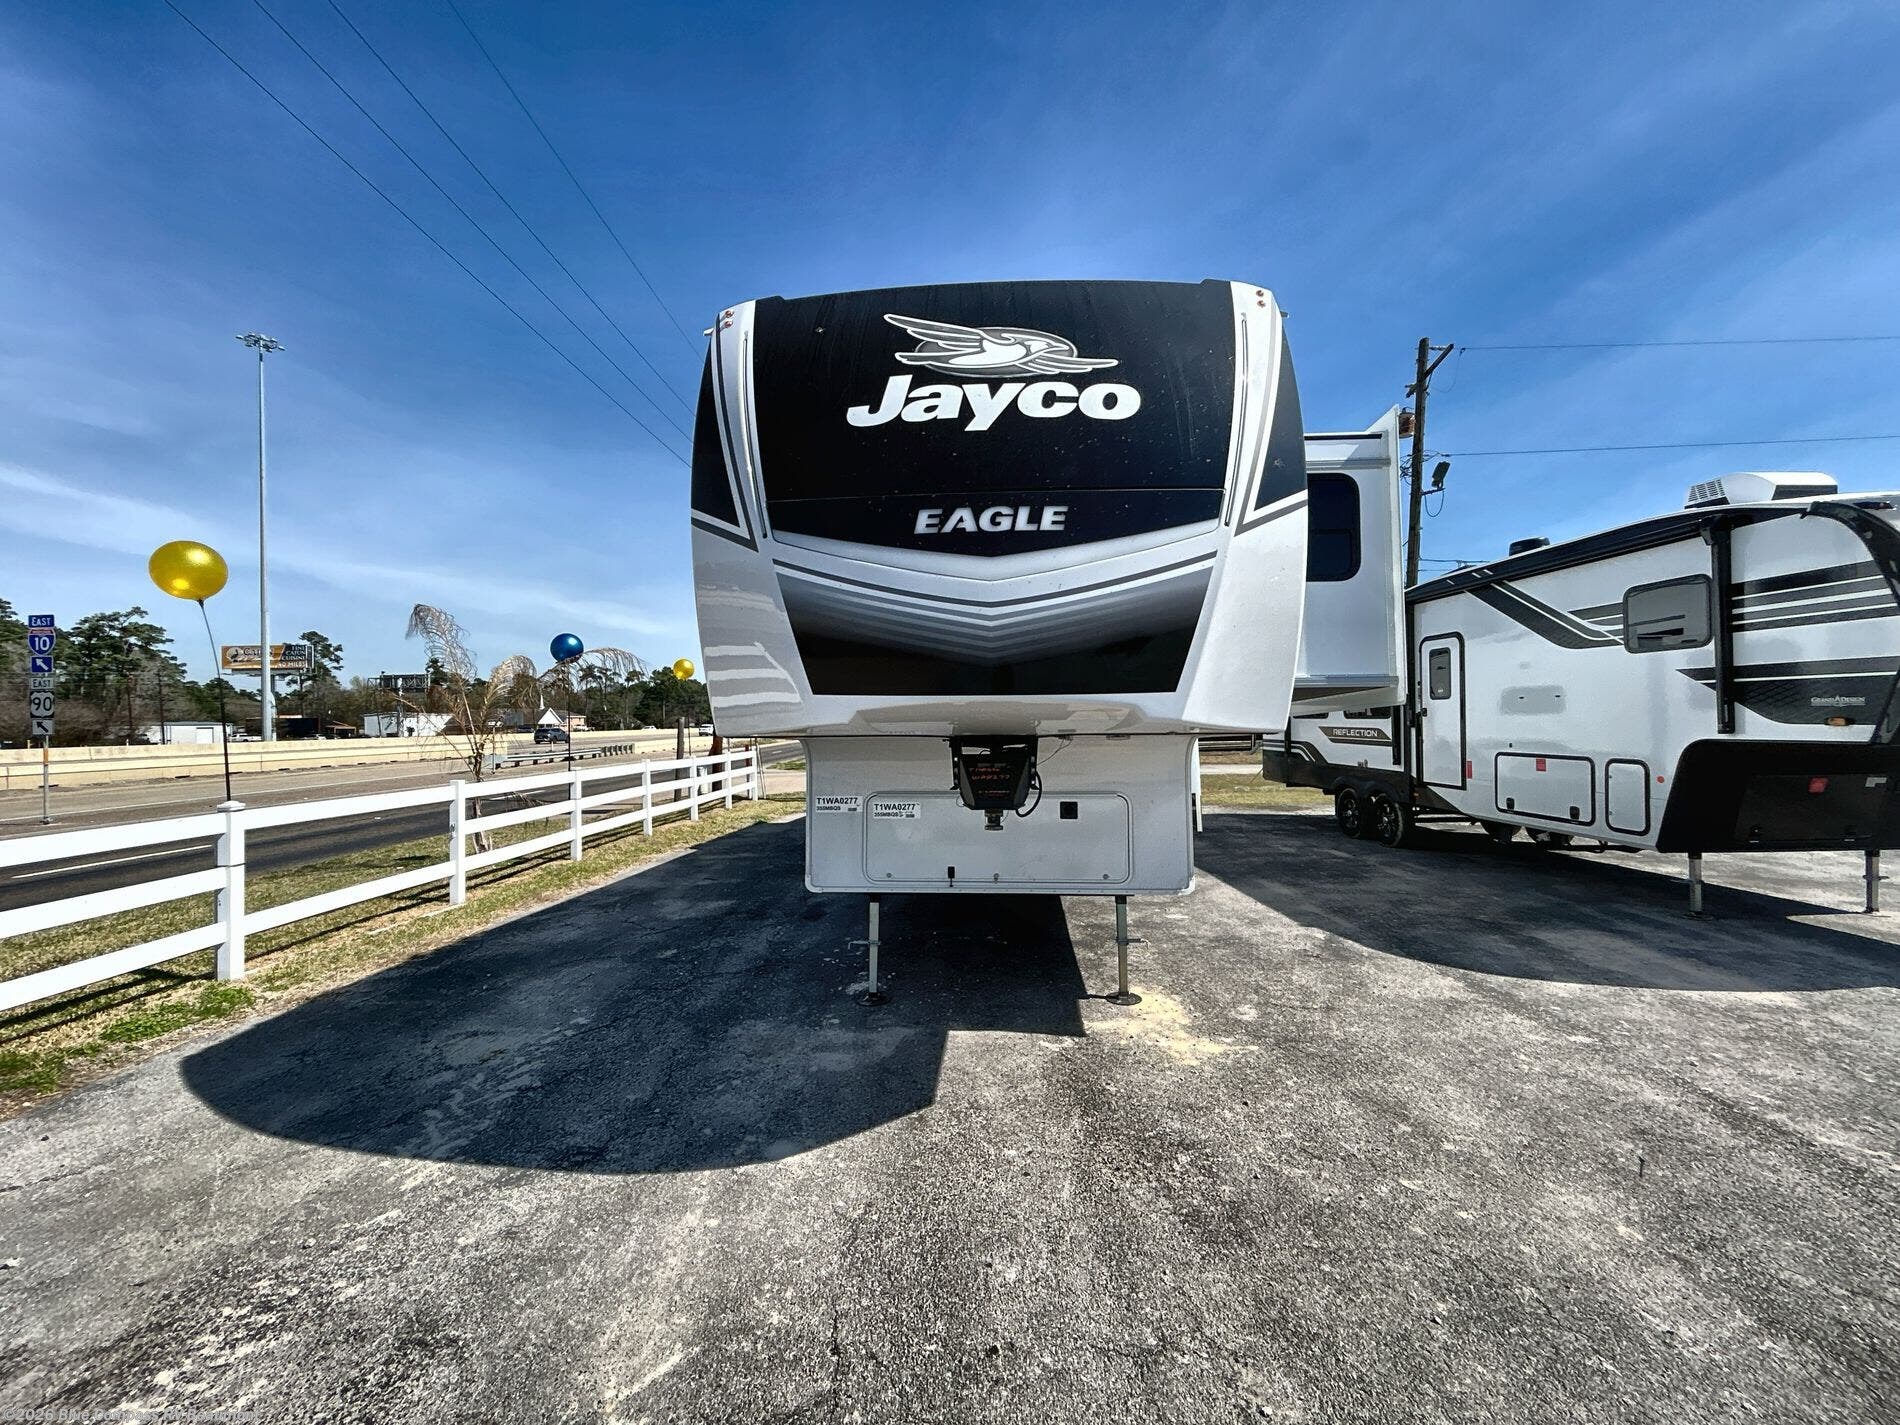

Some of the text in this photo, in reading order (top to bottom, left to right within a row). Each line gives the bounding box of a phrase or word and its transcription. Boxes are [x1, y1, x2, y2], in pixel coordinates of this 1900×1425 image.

[846, 374, 1142, 431] Jayco
[914, 505, 1069, 535] EAGLE
[31, 616, 51, 626] EAST
[34, 636, 50, 651] 10
[32, 697, 52, 712] 90
[1332, 728, 1378, 737] REFLECTION
[873, 803, 916, 811] T1WA0277
